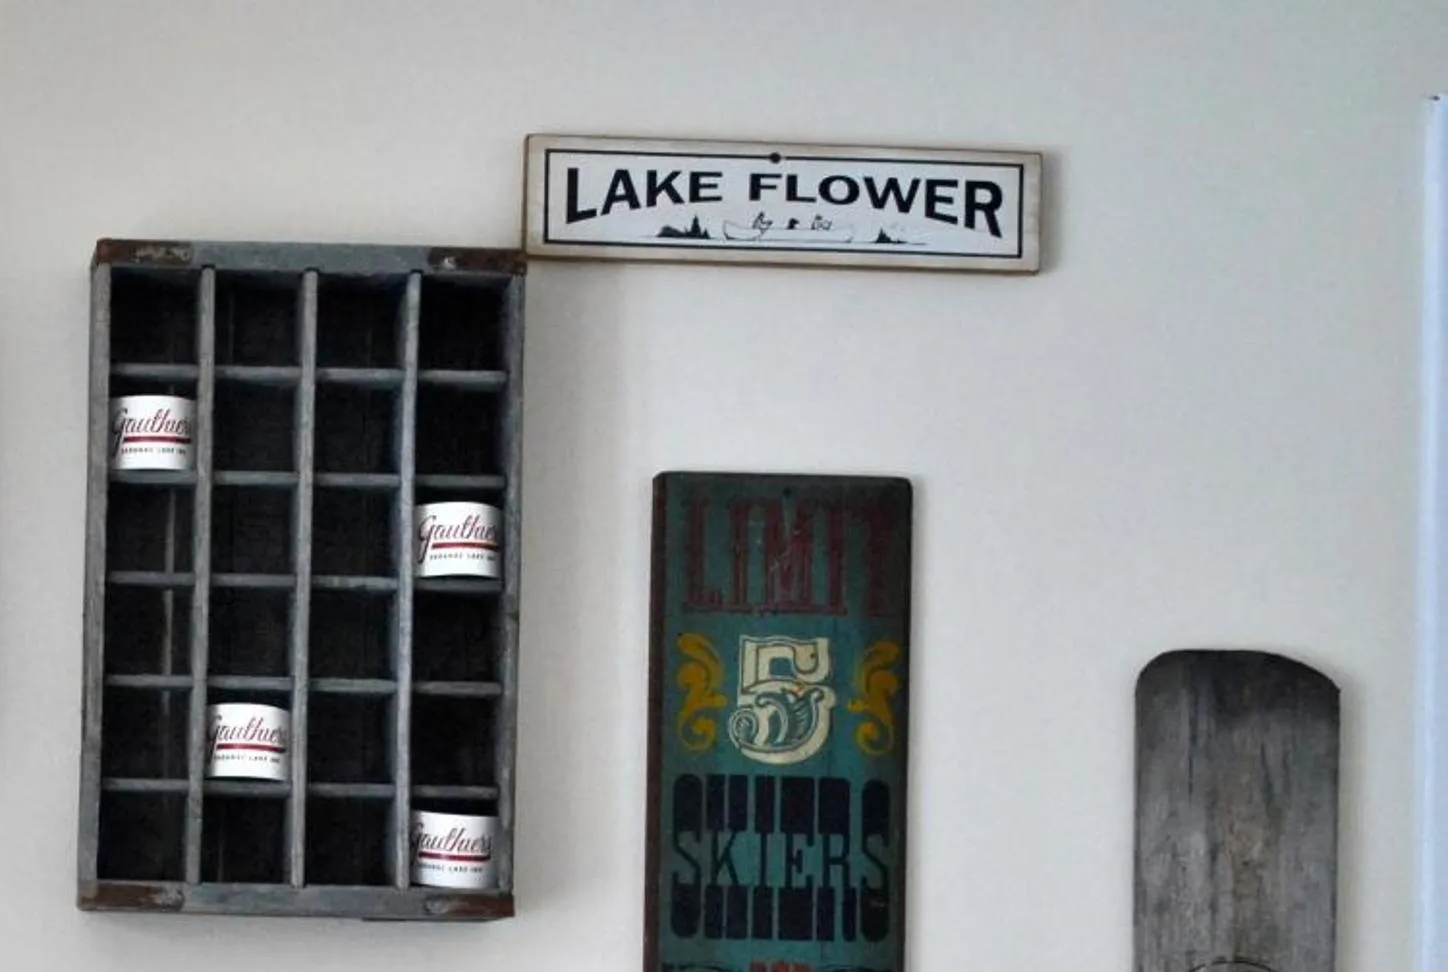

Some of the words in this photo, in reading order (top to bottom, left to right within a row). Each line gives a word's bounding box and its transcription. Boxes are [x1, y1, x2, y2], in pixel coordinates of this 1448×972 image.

[566, 166, 723, 225] LAKE
[748, 172, 1004, 239] FLOWER
[728, 635, 837, 765] 5
[669, 773, 892, 942] SKIERS
